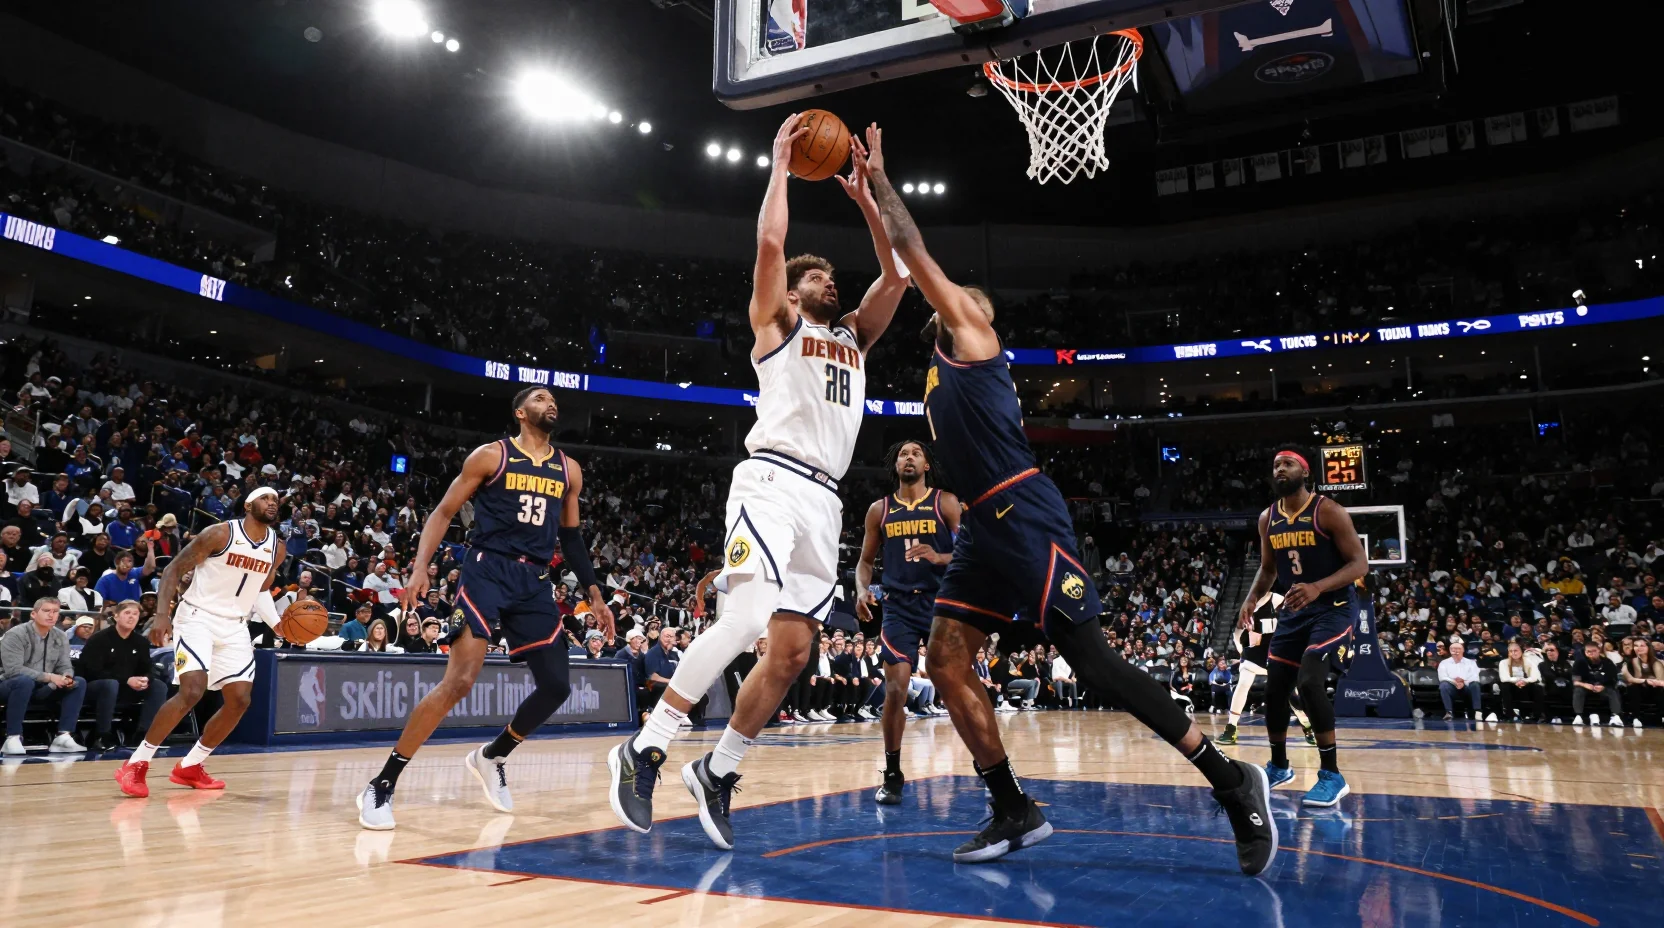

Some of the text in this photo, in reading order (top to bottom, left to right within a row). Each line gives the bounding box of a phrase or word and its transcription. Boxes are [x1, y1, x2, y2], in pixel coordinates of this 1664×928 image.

[505, 472, 565, 498] DENVER
[517, 494, 547, 526] 33
[885, 520, 937, 538] DENVER
[1288, 549, 1303, 575] 3
[235, 573, 248, 597] 1
